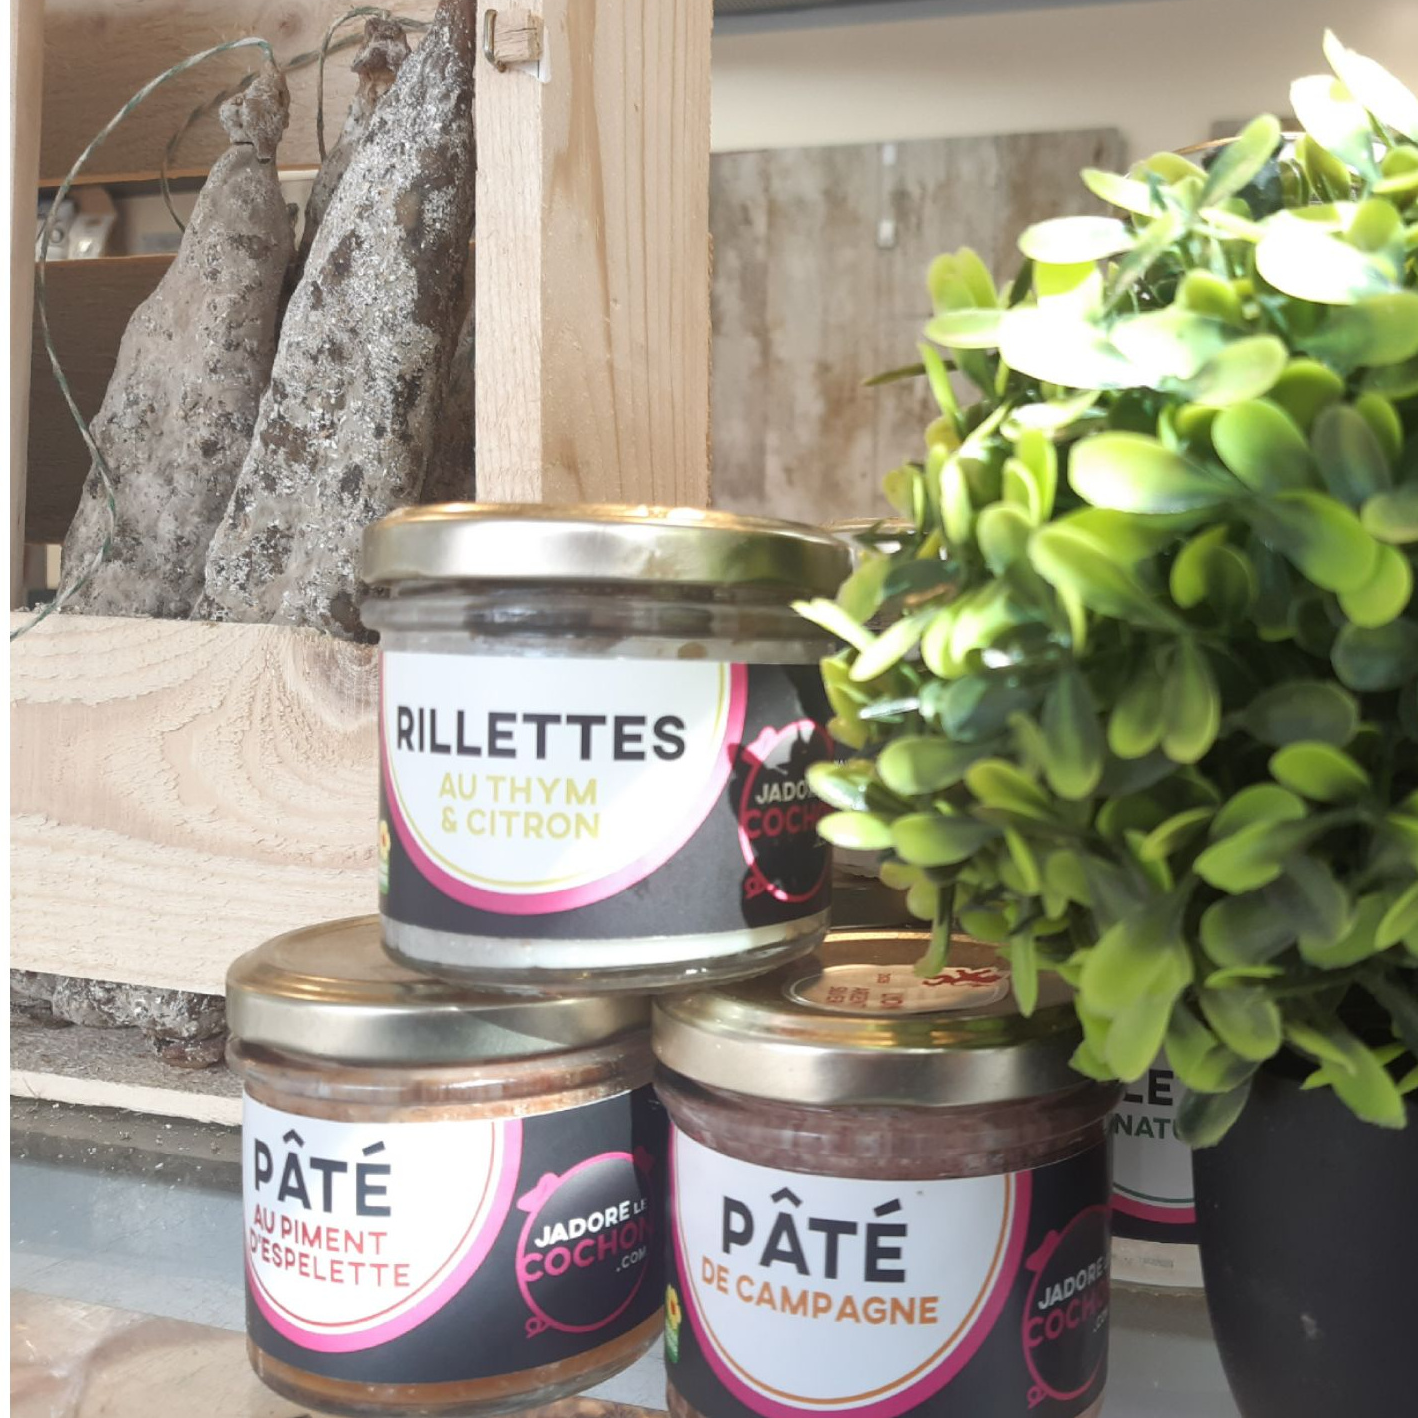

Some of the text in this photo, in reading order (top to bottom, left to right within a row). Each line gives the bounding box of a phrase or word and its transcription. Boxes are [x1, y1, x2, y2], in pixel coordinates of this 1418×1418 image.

[396, 705, 687, 762] RILLETTES
[439, 771, 598, 807] AU THYM
[755, 780, 814, 805] JADO
[441, 809, 601, 841] & CITRON
[254, 1128, 392, 1217] PÂTÉ
[254, 1203, 388, 1256] AU PIMENT
[521, 1216, 656, 1282] COCHON
[534, 1200, 631, 1248] JADORE
[721, 1186, 909, 1283] PÂTÉ
[250, 1227, 411, 1287] D'ESPELETTE
[701, 1255, 940, 1326] DE CAMPAGNE
[1025, 1280, 1109, 1348] COCH
